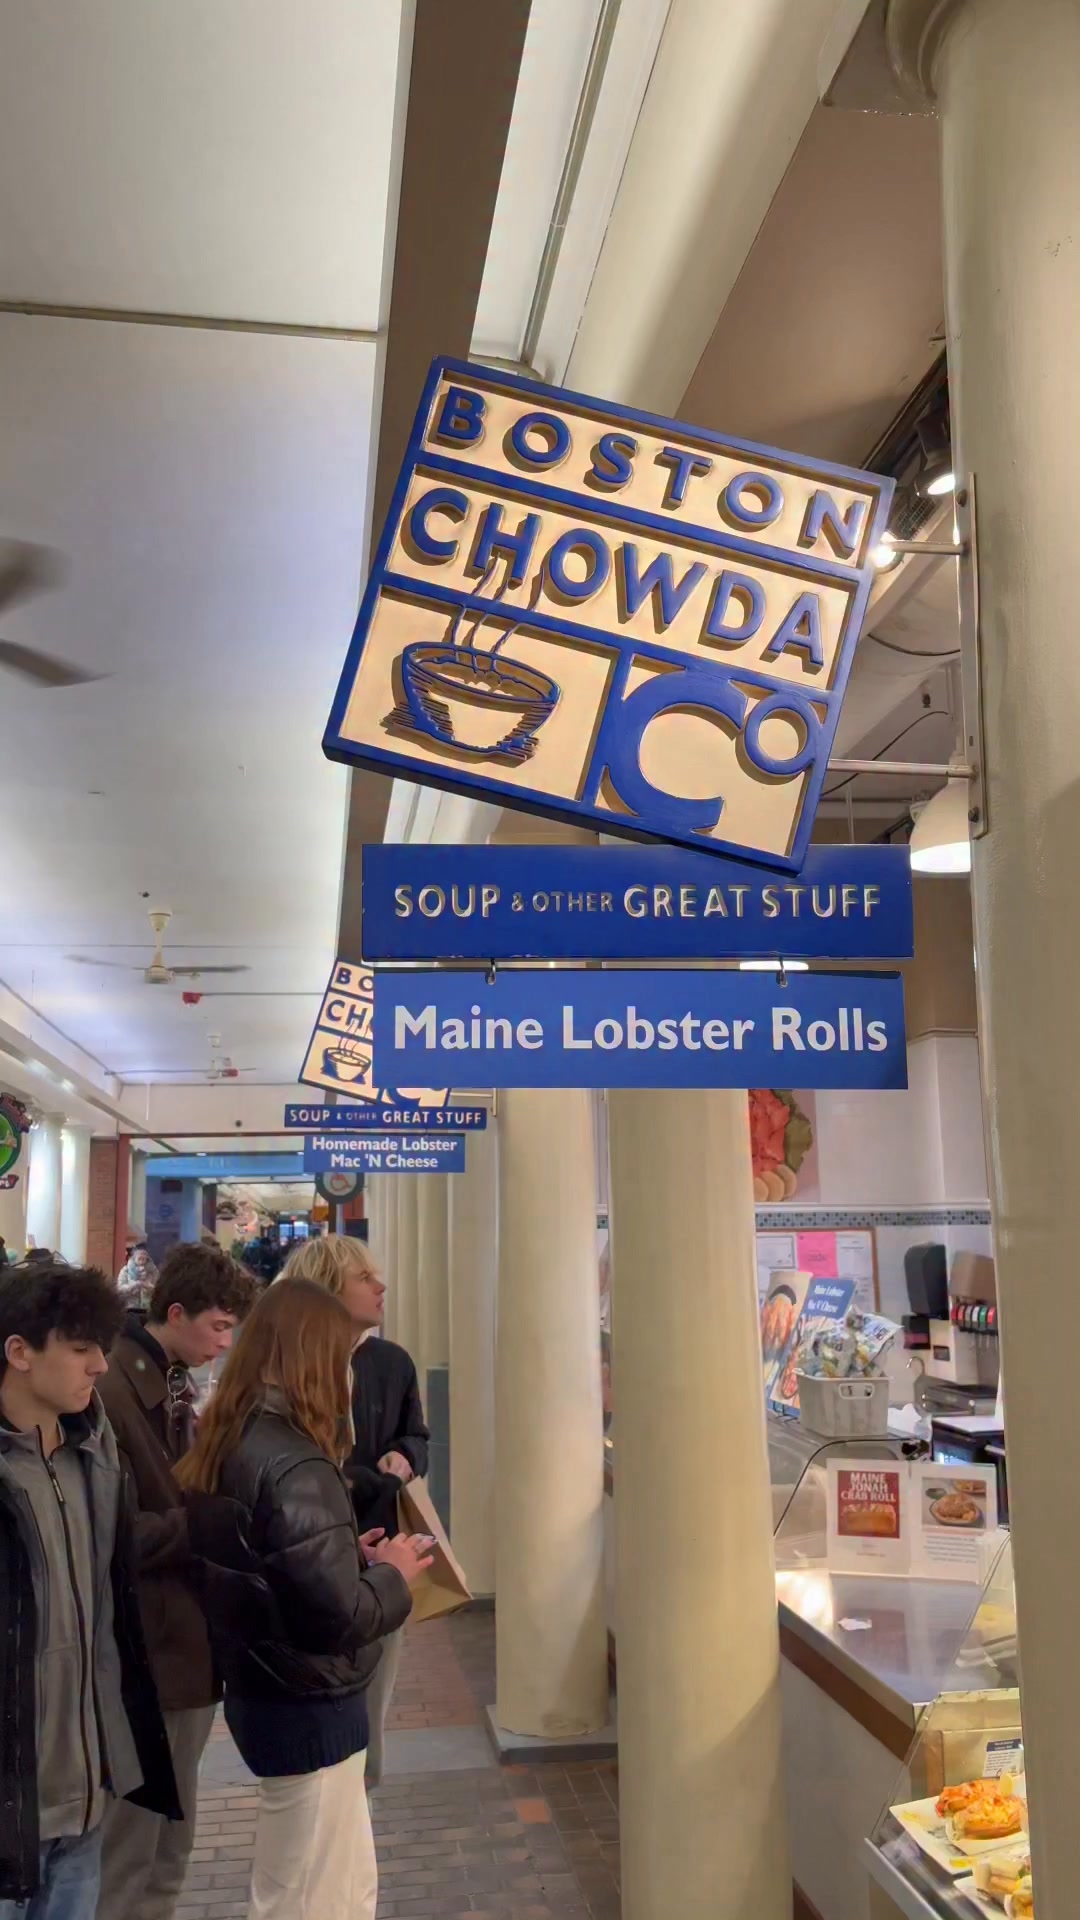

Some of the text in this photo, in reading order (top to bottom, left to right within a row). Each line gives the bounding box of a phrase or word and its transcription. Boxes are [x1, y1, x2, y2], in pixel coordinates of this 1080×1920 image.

[434, 386, 867, 553] BOSTON
[406, 487, 826, 672] CHOWDA
[394, 883, 882, 919] SOUP & OTHER GREAT STUFF
[393, 1003, 889, 1053] Maine Lobster Rolls
[290, 1108, 330, 1122] SOUP
[346, 1112, 377, 1121] OTHER
[382, 1110, 431, 1124] GREAT
[436, 1111, 482, 1125] STUFF
[312, 1136, 458, 1151] Homemade Lobster
[331, 1154, 439, 1168] Mac 'N Cheese
[850, 1472, 886, 1483] MAINE
[851, 1483, 888, 1493] JONAH
[840, 1491, 896, 1502] CRAB ROLL
